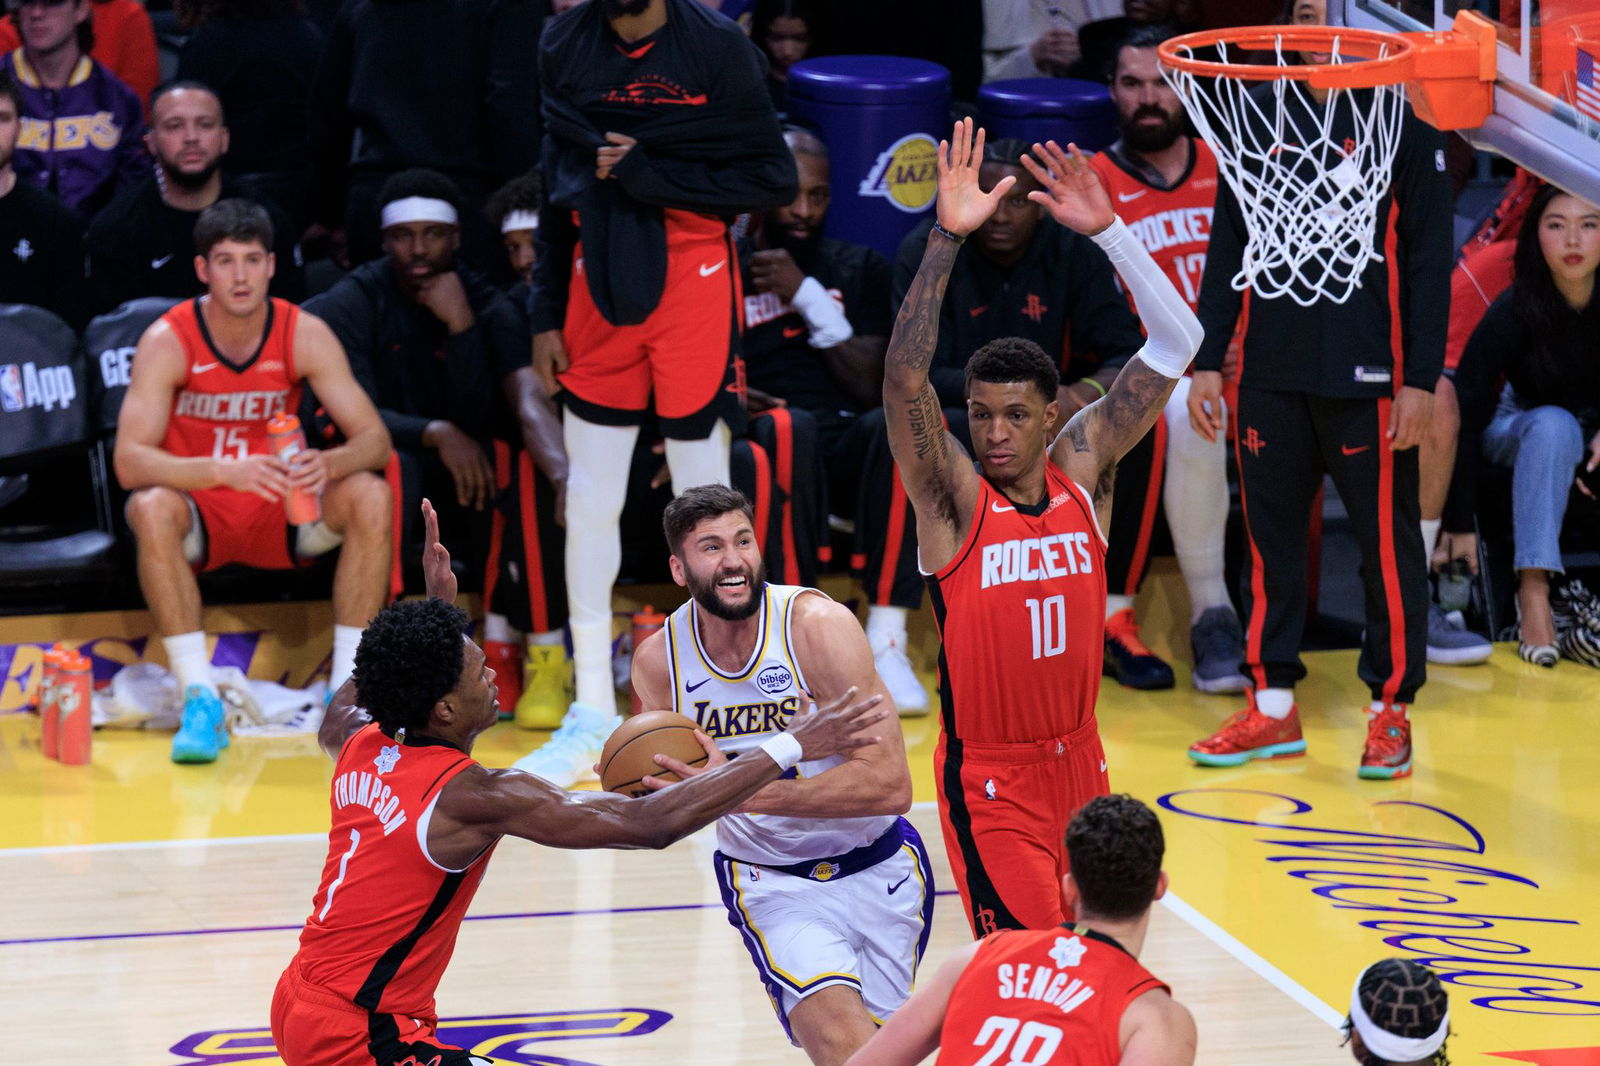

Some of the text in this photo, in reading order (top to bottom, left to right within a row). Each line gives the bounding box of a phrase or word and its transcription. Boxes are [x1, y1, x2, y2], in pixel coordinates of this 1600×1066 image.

[22, 361, 77, 412] App
[981, 531, 1092, 589] ROCKETS
[1025, 594, 1066, 660] 10
[760, 673, 790, 684] bibigo
[694, 697, 797, 740] LAKERS
[334, 771, 407, 836] THOMPSON
